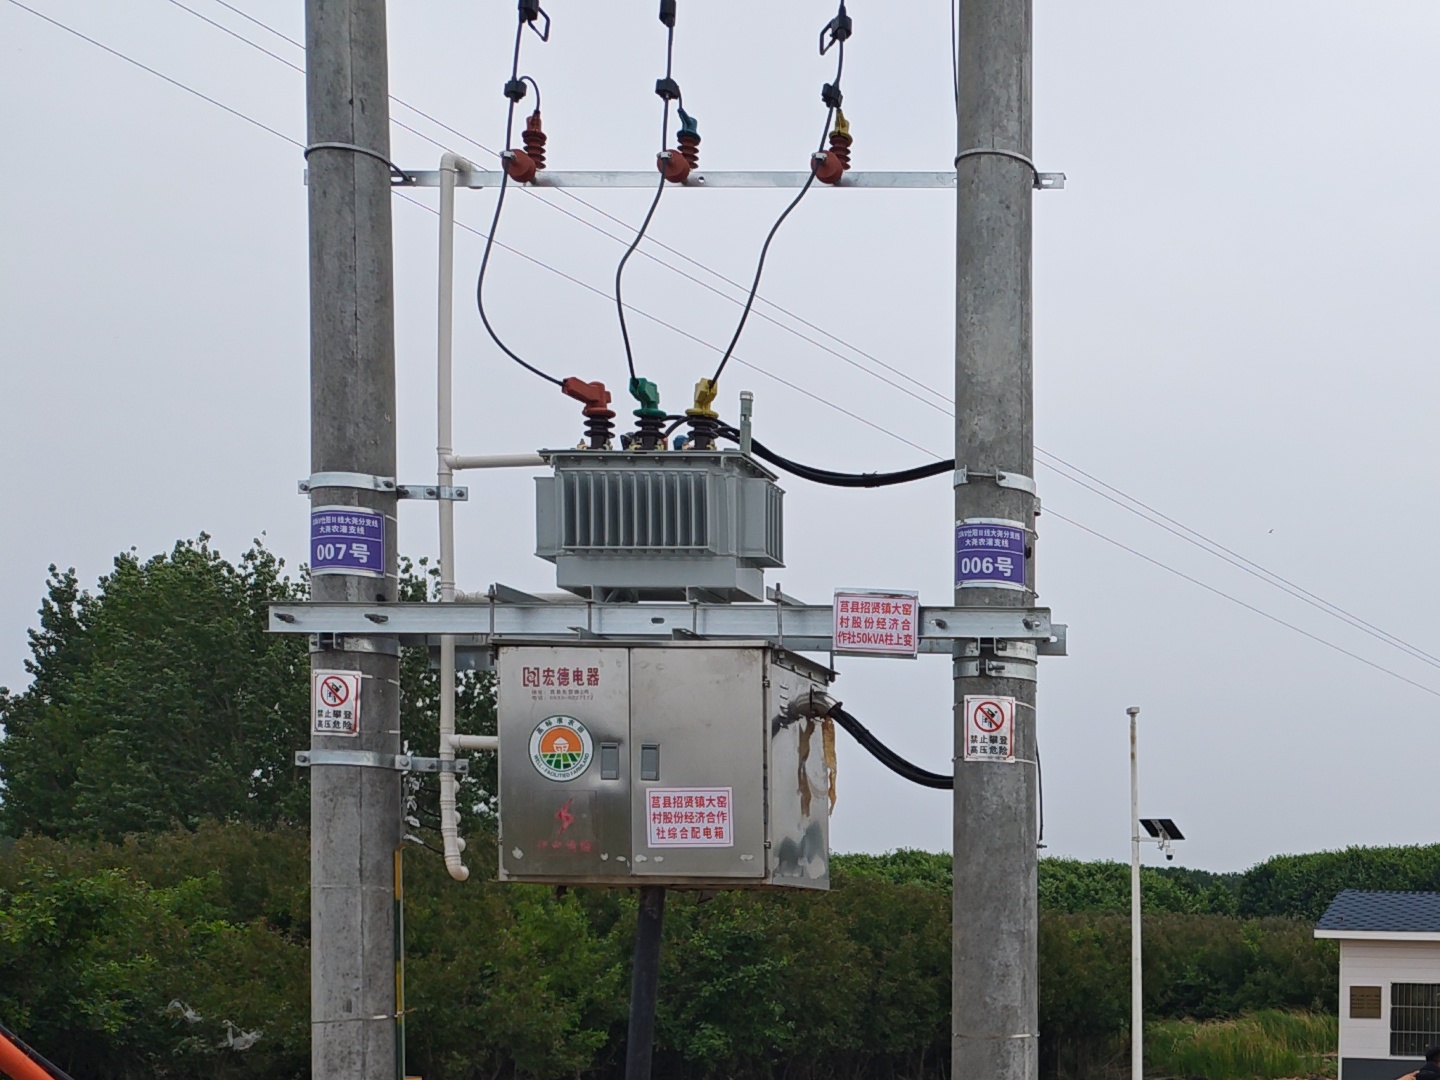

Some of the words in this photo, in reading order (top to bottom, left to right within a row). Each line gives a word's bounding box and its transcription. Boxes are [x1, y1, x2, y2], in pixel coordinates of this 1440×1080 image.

[316, 542, 371, 564] 007号
[961, 556, 1014, 577] 006号
[840, 600, 913, 616] 莒县招贤镇大窑
[840, 615, 912, 631] 村股份经济合
[837, 630, 913, 647] 作社50kVA柱上变
[542, 667, 600, 687] 宏德电器
[317, 709, 353, 720] 禁止攀登
[317, 719, 353, 730] 高压危险
[970, 734, 1008, 745] 禁止攀登
[970, 745, 1008, 756] 高压危险
[651, 795, 727, 809] 莒县招贤镇大窑
[652, 810, 727, 825] 村股份经济合作
[656, 826, 724, 840] 社综合配电箱
